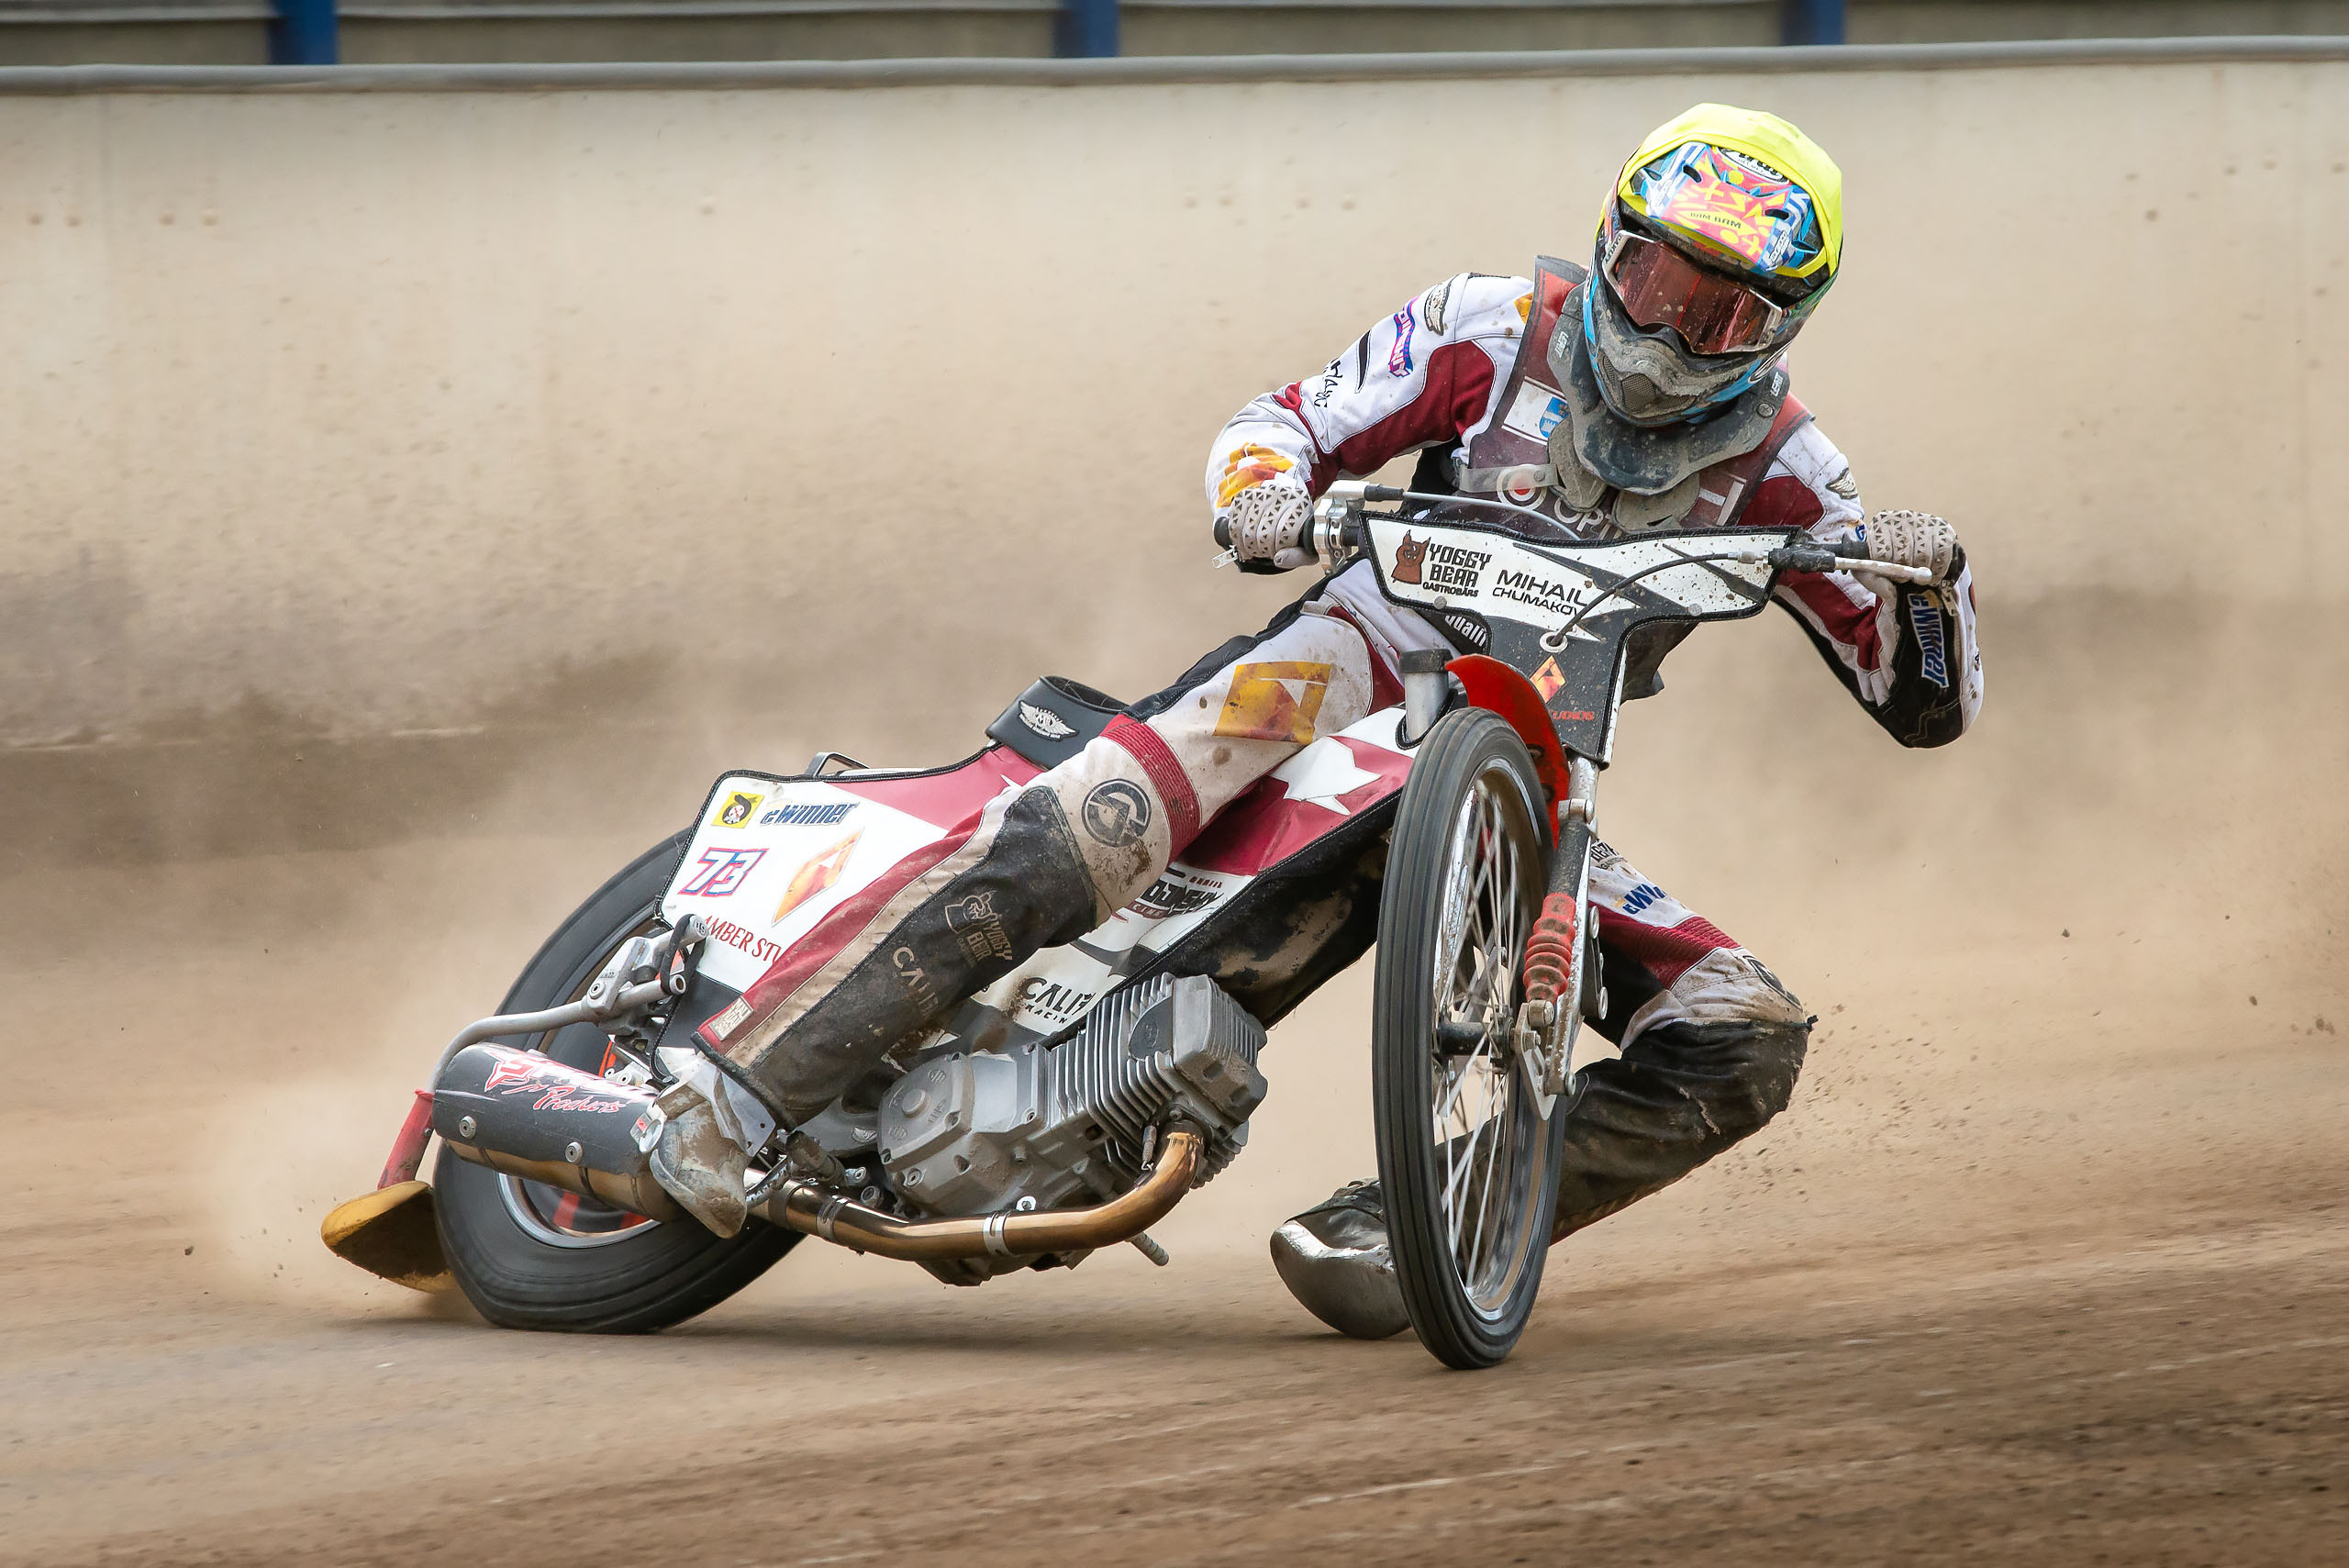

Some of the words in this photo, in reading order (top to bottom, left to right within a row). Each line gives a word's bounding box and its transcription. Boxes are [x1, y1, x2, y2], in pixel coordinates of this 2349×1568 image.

[1429, 543, 1493, 571] YOGGY
[1430, 563, 1480, 588] BEAR
[1497, 569, 1588, 607] MIHAIL
[760, 803, 858, 825] eWinner
[677, 847, 770, 897] 73
[533, 1085, 627, 1114] Products
